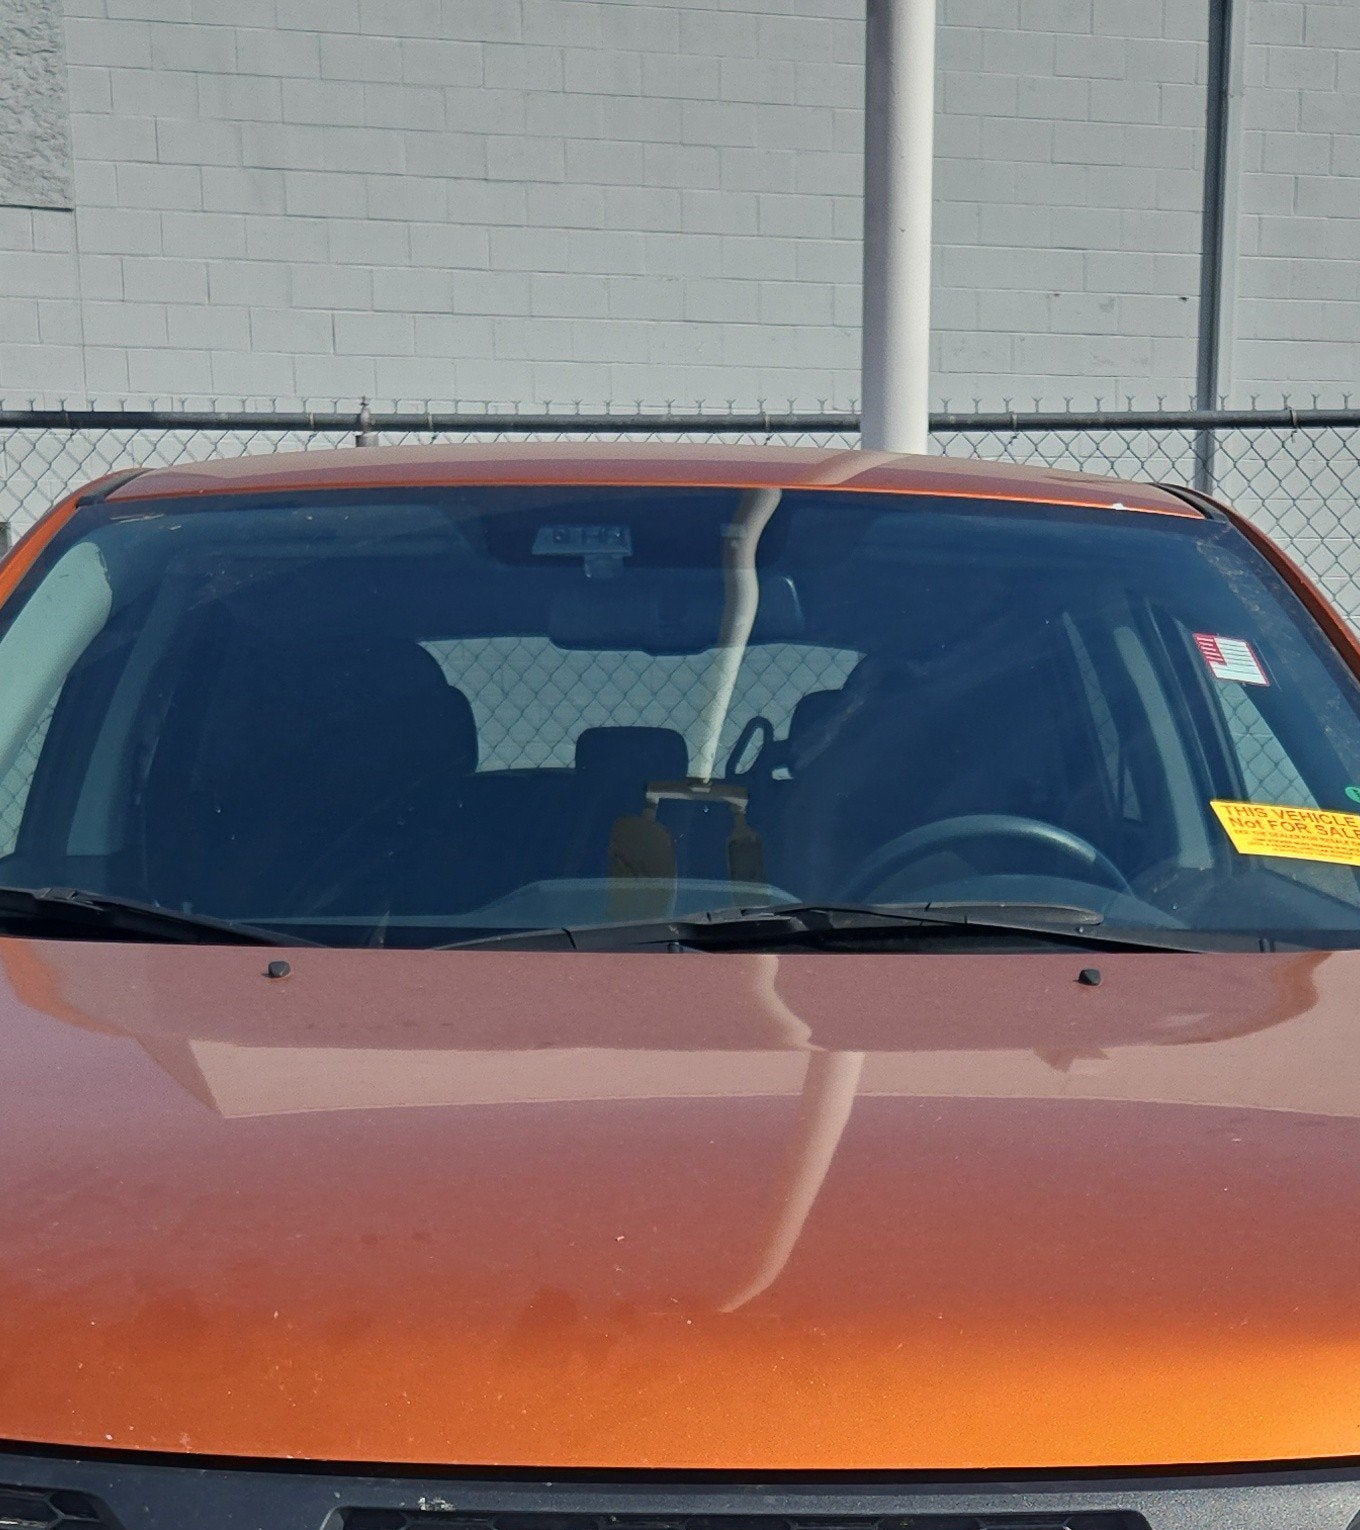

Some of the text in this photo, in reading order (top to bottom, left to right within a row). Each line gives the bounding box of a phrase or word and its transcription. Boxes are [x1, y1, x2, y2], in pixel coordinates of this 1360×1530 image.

[1220, 805, 1360, 828] THIS VEHICLE
[1228, 816, 1265, 830] Not
[1267, 819, 1312, 834] FOR
